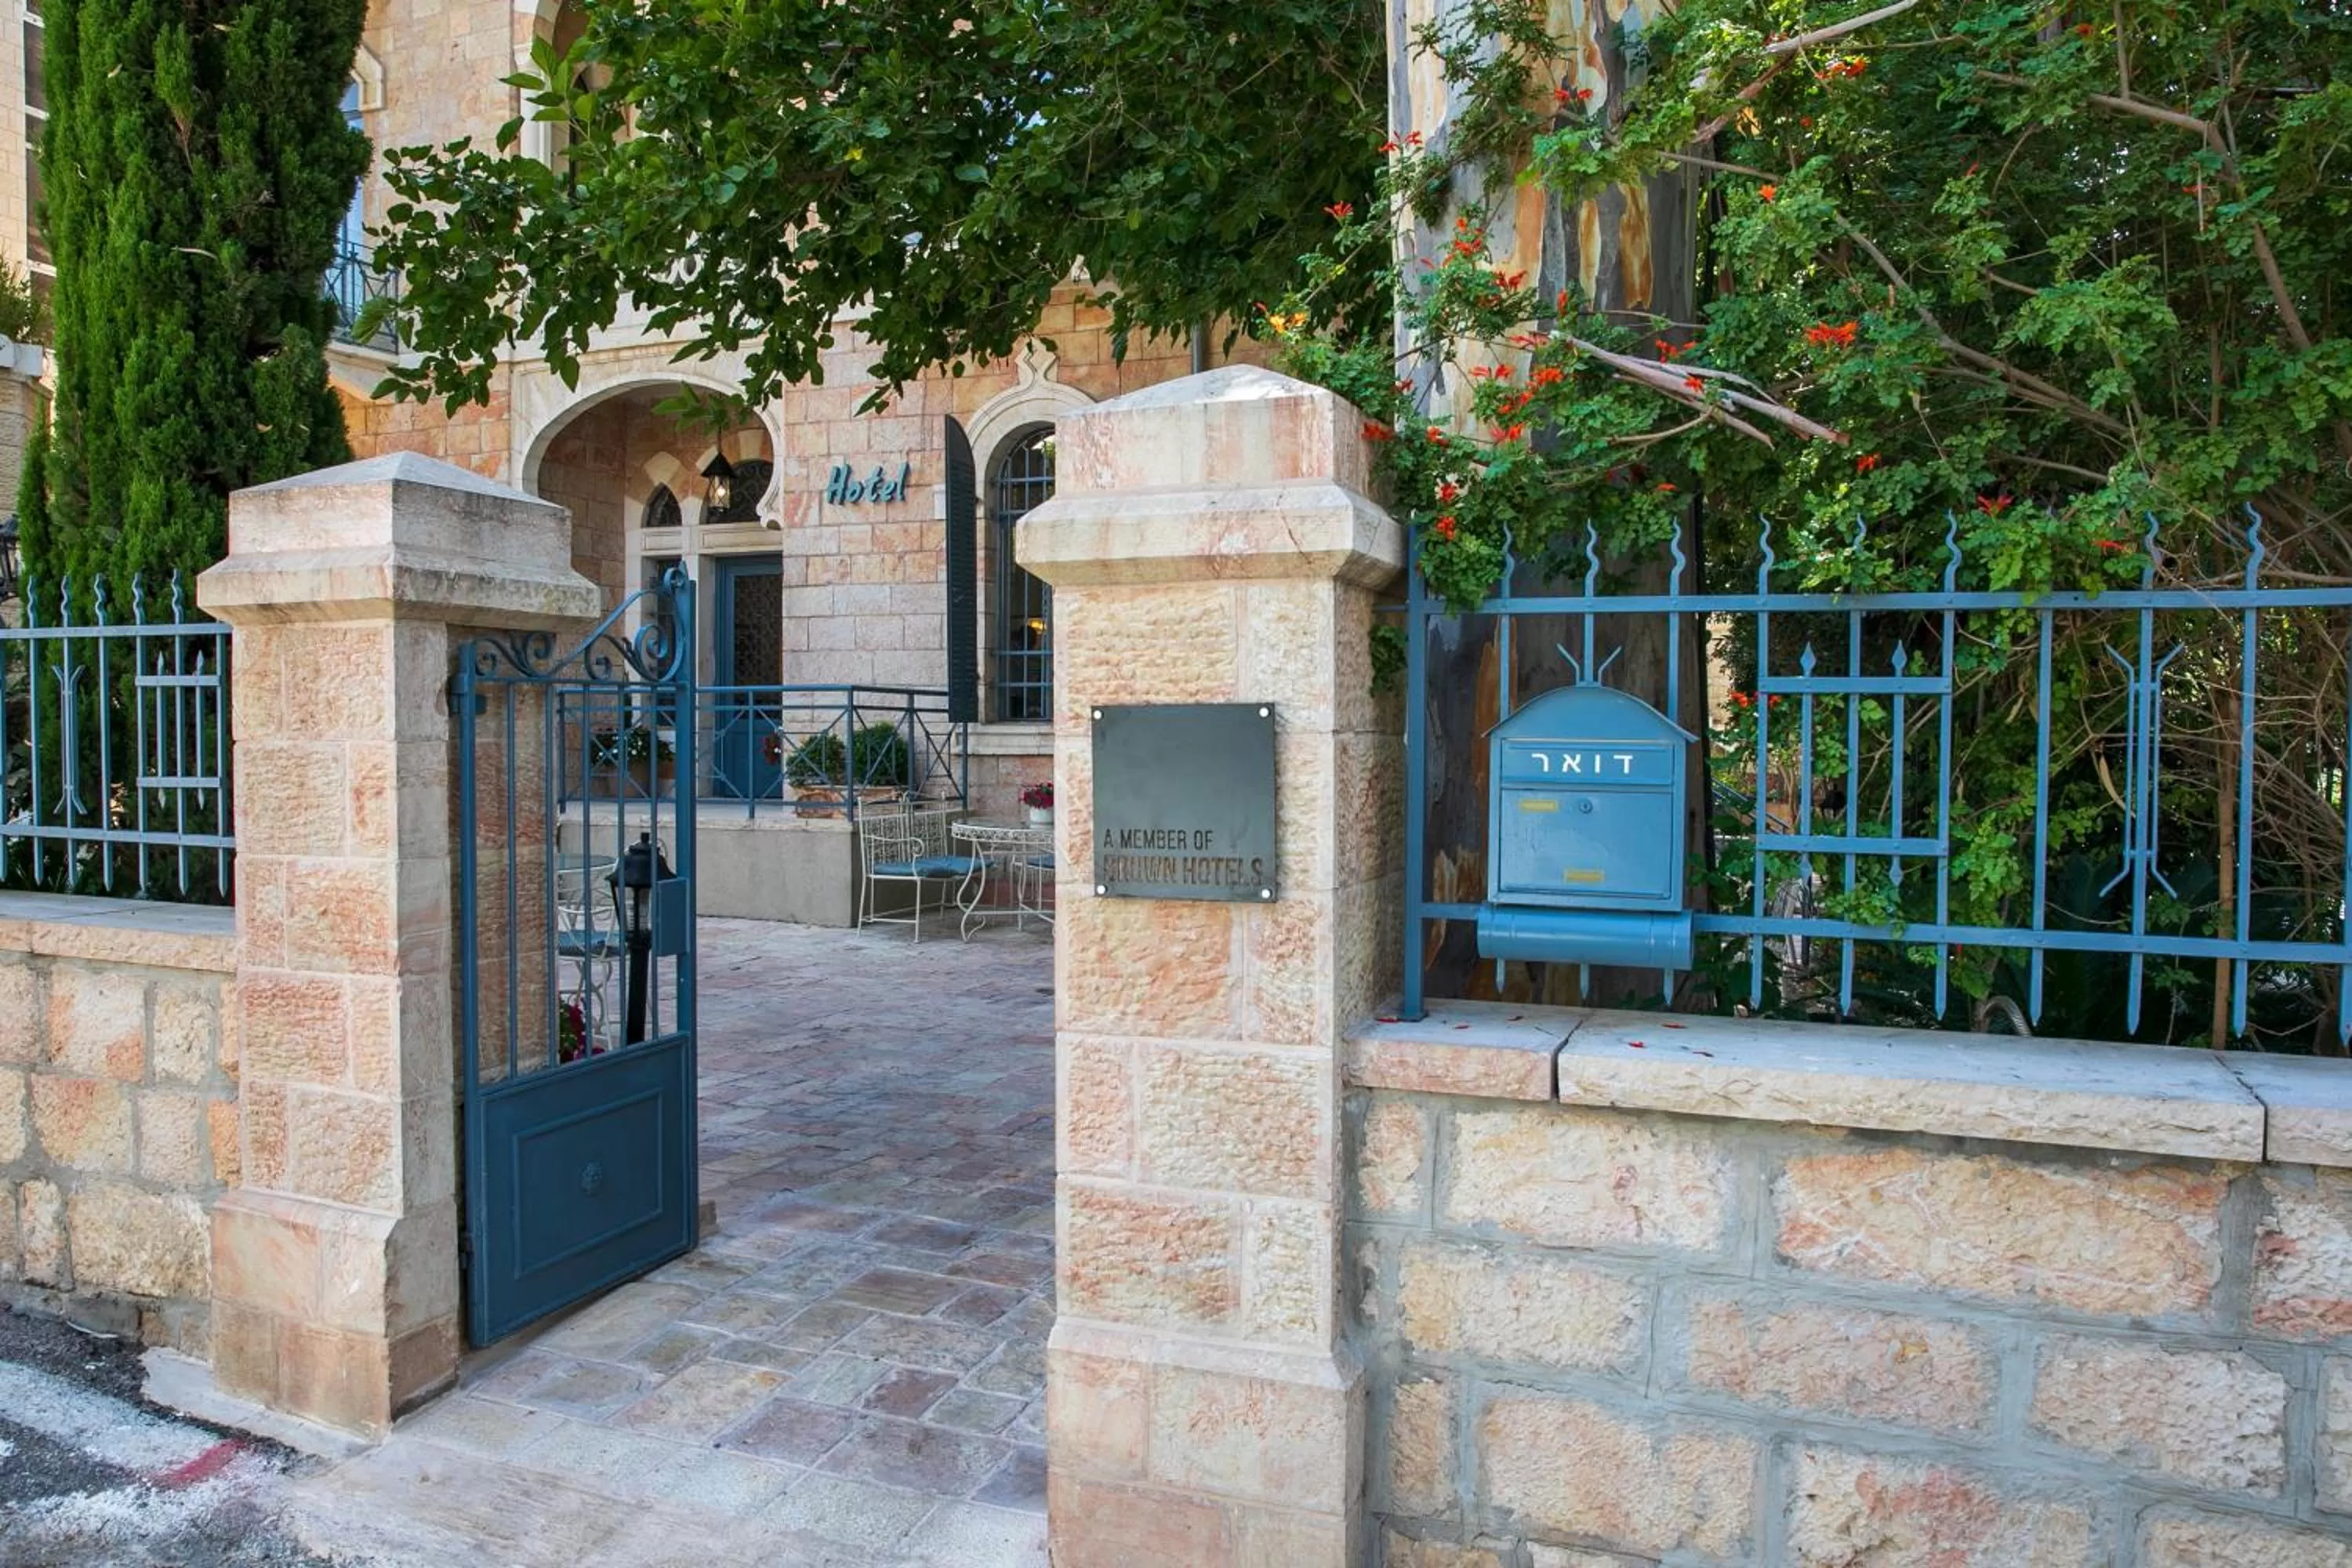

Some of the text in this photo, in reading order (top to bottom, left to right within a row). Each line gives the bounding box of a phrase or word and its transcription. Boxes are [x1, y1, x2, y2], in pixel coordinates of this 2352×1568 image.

[827, 461, 909, 504] Hotel
[1531, 753, 1633, 774] דואר
[1103, 829, 1214, 850] A MEMBER OF
[1182, 856, 1263, 886] HOTELS
